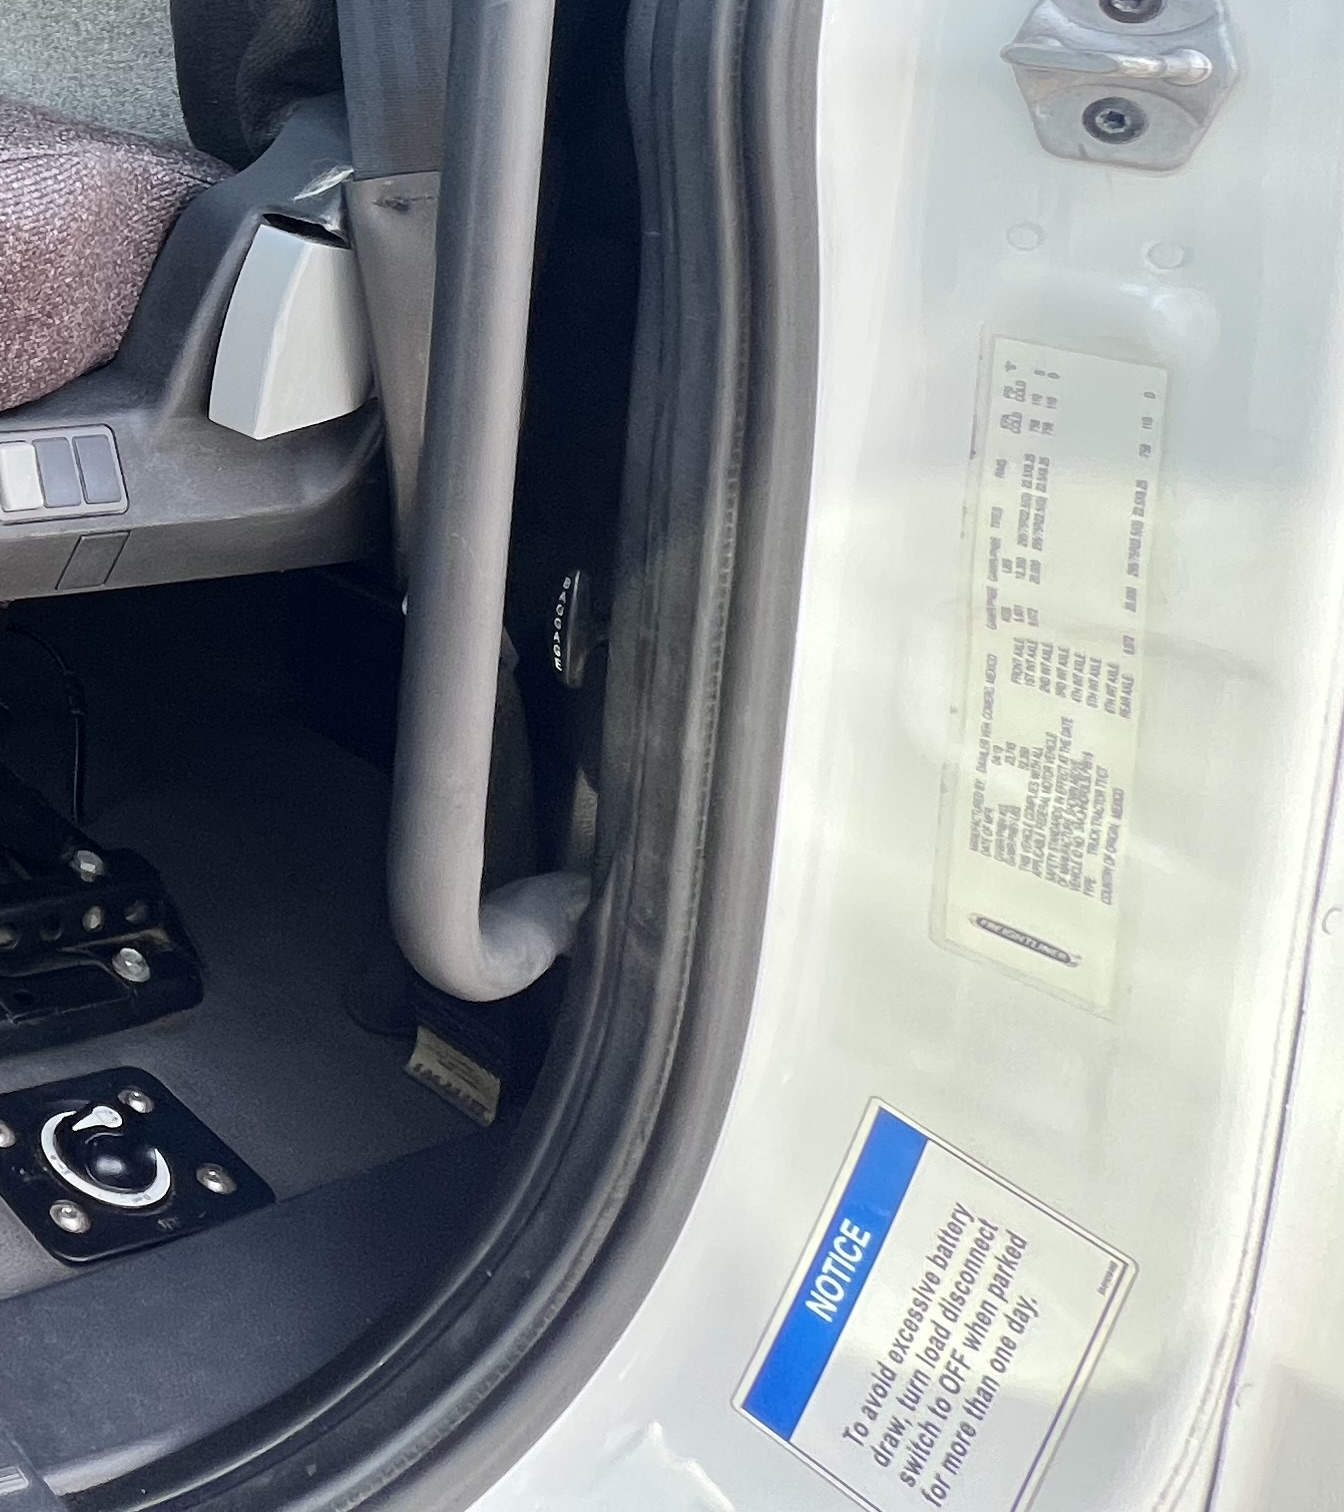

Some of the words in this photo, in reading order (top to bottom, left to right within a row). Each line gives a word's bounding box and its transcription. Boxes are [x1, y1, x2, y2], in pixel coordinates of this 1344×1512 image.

[553, 576, 572, 672] BAGGAGE
[805, 1218, 872, 1324] NOTICE
[987, 1229, 1029, 1303] parked
[842, 1425, 870, 1447] To
[860, 1360, 898, 1422] avoid
[888, 1270, 941, 1365] excessive
[926, 1201, 975, 1271] battery
[870, 1415, 912, 1468] draw,
[895, 1367, 932, 1412] turn
[915, 1318, 952, 1369] load
[937, 1217, 999, 1324] disconnect
[962, 1299, 999, 1352] when
[927, 1396, 952, 1421] to
[939, 1348, 972, 1395] OFF
[899, 1419, 942, 1488] switch
[921, 1474, 952, 1508] for
[941, 1421, 977, 1476] more
[962, 1374, 1001, 1421] than
[989, 1335, 1017, 1376] one
